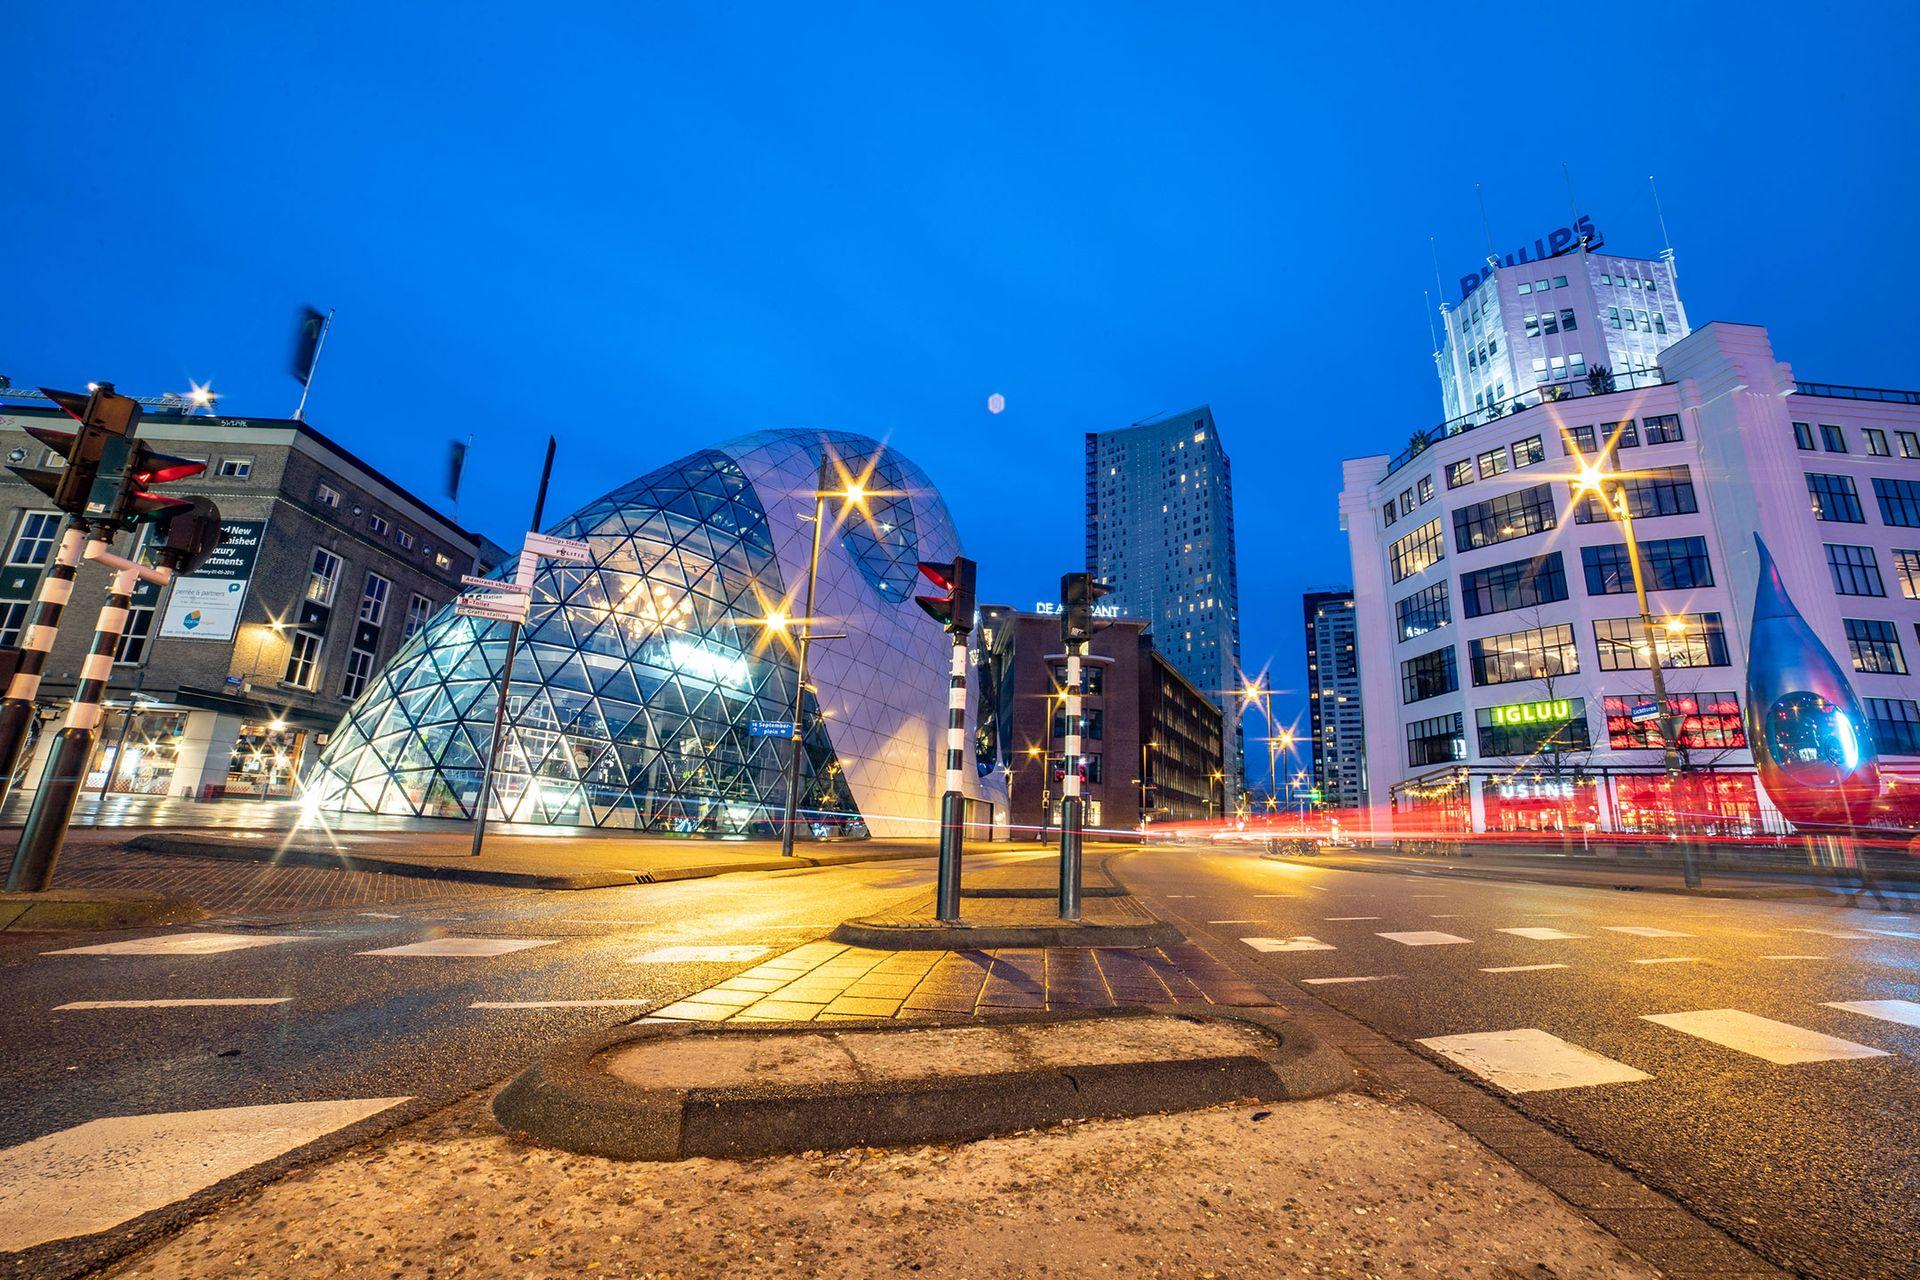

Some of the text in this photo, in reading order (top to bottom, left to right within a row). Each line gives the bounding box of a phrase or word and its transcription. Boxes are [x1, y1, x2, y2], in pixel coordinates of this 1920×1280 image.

[230, 526, 252, 535] New
[565, 540, 587, 548] Stadion
[466, 577, 522, 592] Admirant shopping
[467, 608, 509, 620] Gratis stalling
[1036, 602, 1054, 615] DE
[1497, 700, 1568, 723] IGLUU
[1500, 782, 1575, 799] USINE
